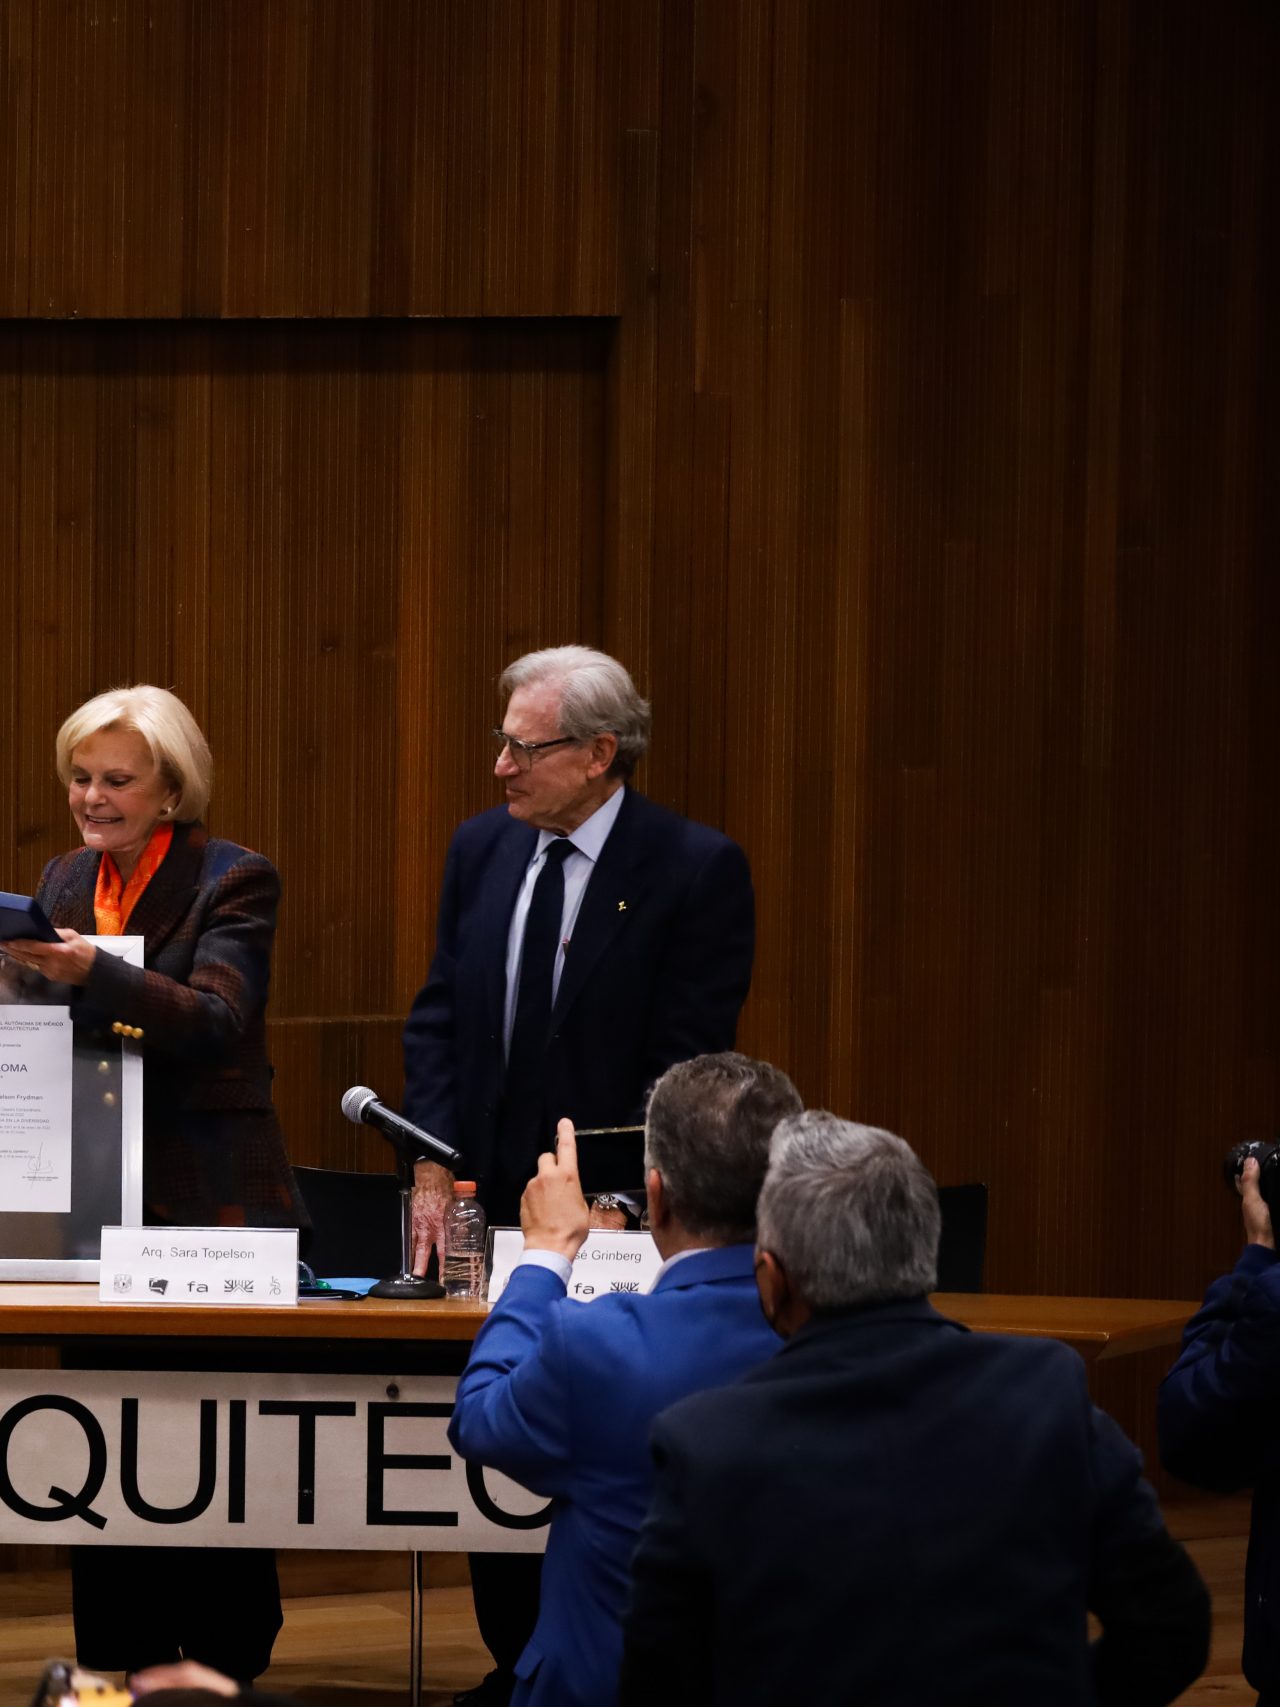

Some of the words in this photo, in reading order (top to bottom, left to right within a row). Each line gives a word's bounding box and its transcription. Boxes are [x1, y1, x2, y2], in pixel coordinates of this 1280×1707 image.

[141, 1246, 165, 1260] Arq.
[170, 1246, 198, 1259] Sara
[202, 1248, 255, 1261] Topelson
[592, 1249, 642, 1264] Grinberg
[187, 1281, 209, 1294] fa
[574, 1282, 595, 1295] fa
